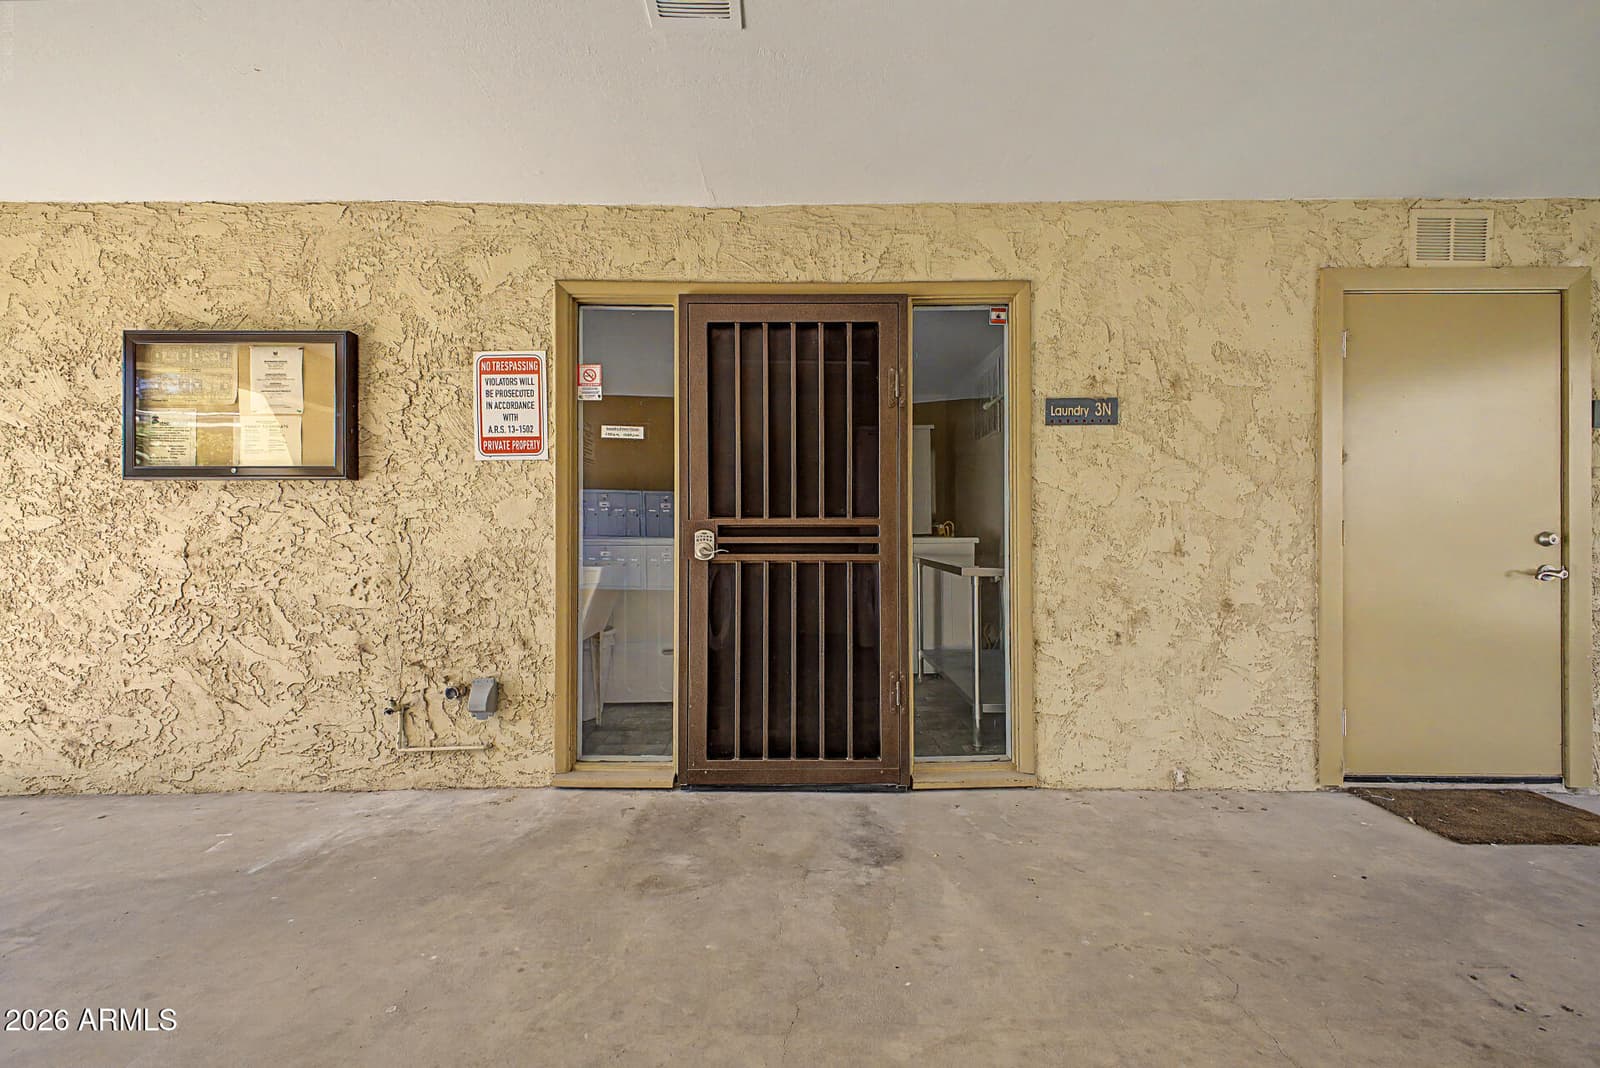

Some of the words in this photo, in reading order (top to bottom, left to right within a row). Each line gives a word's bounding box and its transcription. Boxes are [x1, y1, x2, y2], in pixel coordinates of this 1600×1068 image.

[481, 361, 491, 371] NO
[492, 361, 538, 371] TRESPASSING
[485, 377, 518, 386] VIOLATORS
[519, 377, 535, 386] WILL
[485, 389, 494, 398] BE
[495, 389, 535, 398] PROSECUTED
[486, 401, 493, 410] IN
[494, 401, 535, 410] ACCORDANCE
[1050, 404, 1089, 418] Laundry
[1095, 402, 1112, 416] 3N
[502, 413, 519, 422] WITH
[508, 425, 534, 434] 13-1502
[483, 440, 511, 451] PRIVATE
[512, 440, 540, 451] PROPERTY
